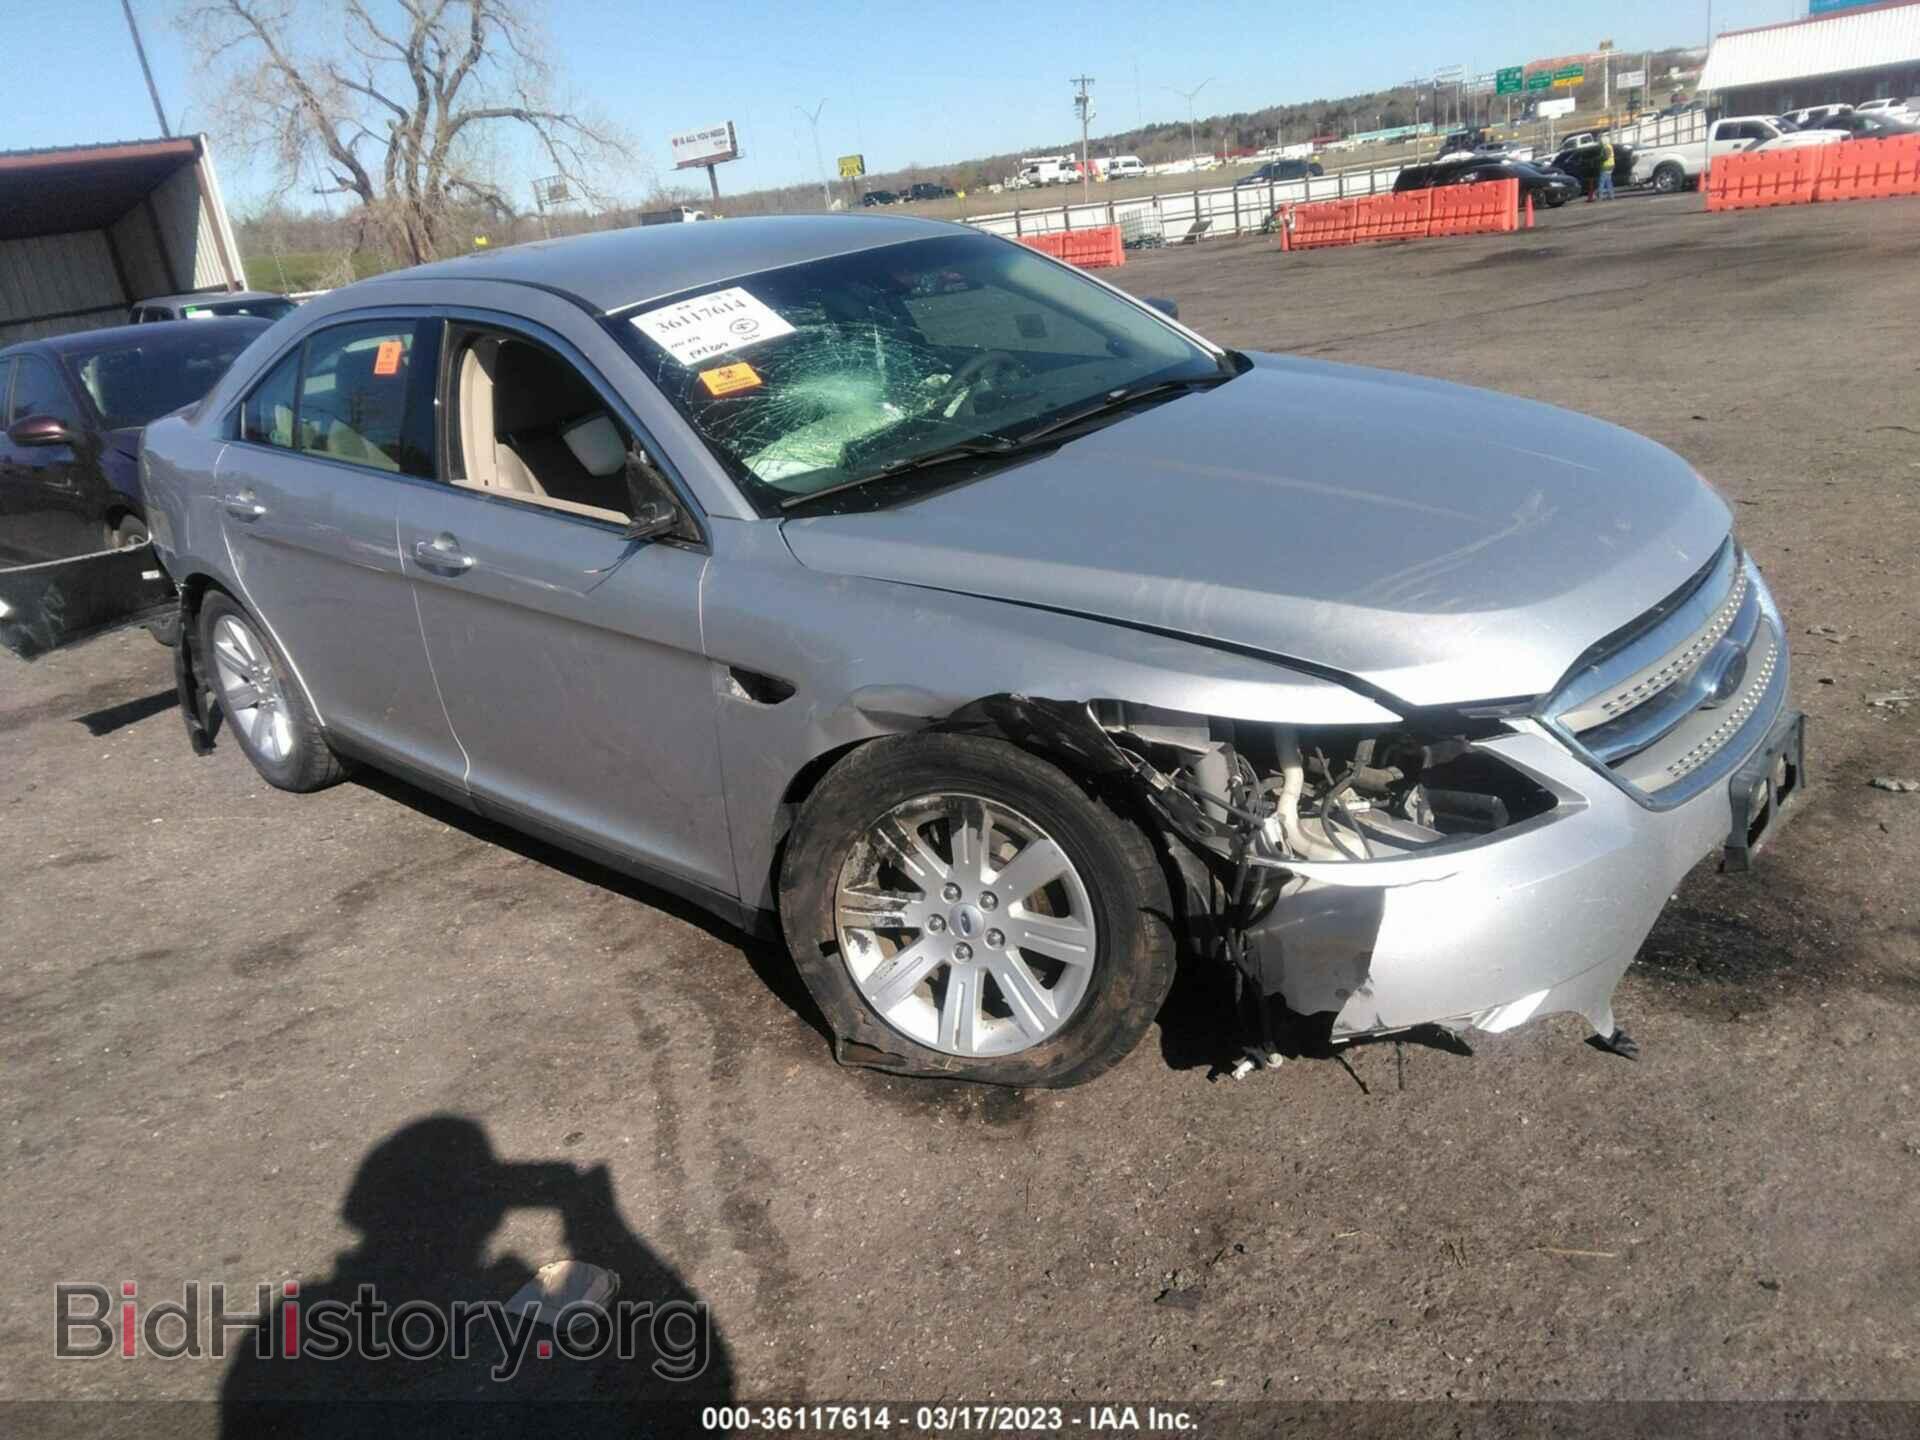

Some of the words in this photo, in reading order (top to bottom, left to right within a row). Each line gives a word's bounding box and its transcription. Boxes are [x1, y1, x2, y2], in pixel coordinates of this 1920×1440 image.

[686, 134, 697, 143] ALL
[697, 131, 709, 141] YOU
[655, 299, 747, 334] 36117614
